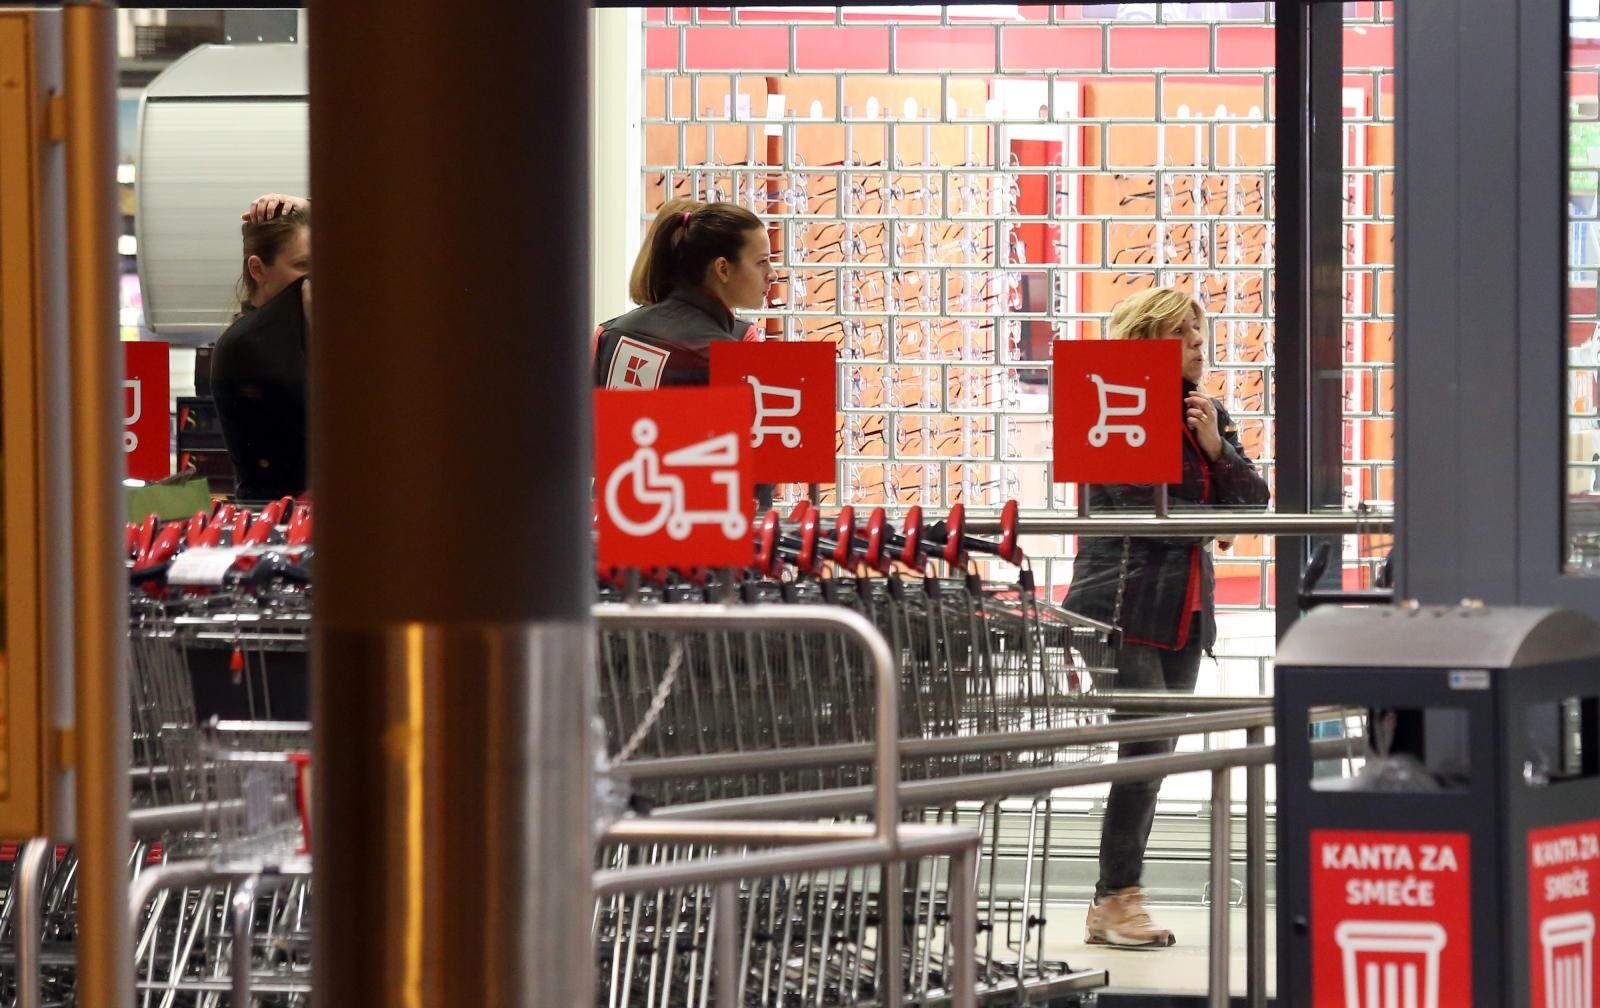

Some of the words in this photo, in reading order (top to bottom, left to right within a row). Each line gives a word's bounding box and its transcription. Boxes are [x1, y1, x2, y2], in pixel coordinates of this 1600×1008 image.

[624, 355, 649, 387] K
[1321, 843, 1415, 871] KANTA
[1418, 844, 1459, 872] ZA
[1531, 837, 1579, 867] KANTA
